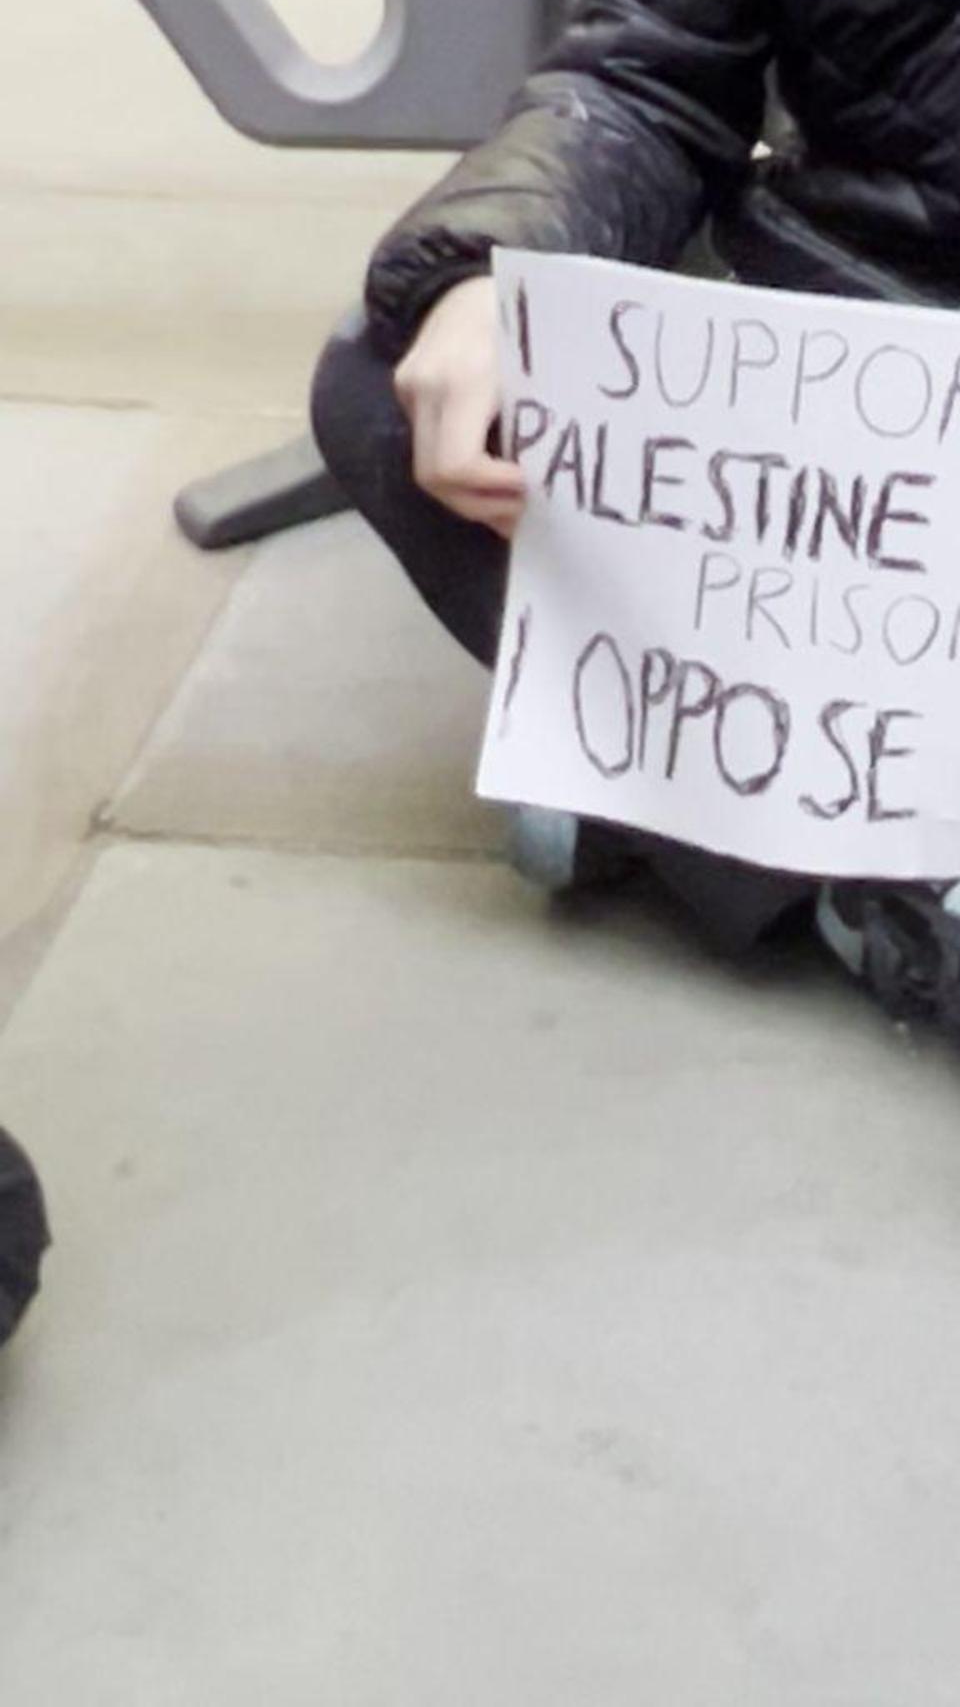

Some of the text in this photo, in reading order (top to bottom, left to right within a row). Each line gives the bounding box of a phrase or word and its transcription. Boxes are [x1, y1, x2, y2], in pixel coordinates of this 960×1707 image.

[515, 279, 532, 376] I
[505, 398, 936, 573] PALESTINE
[501, 606, 530, 726] I
[573, 633, 924, 823] OPPOSE
